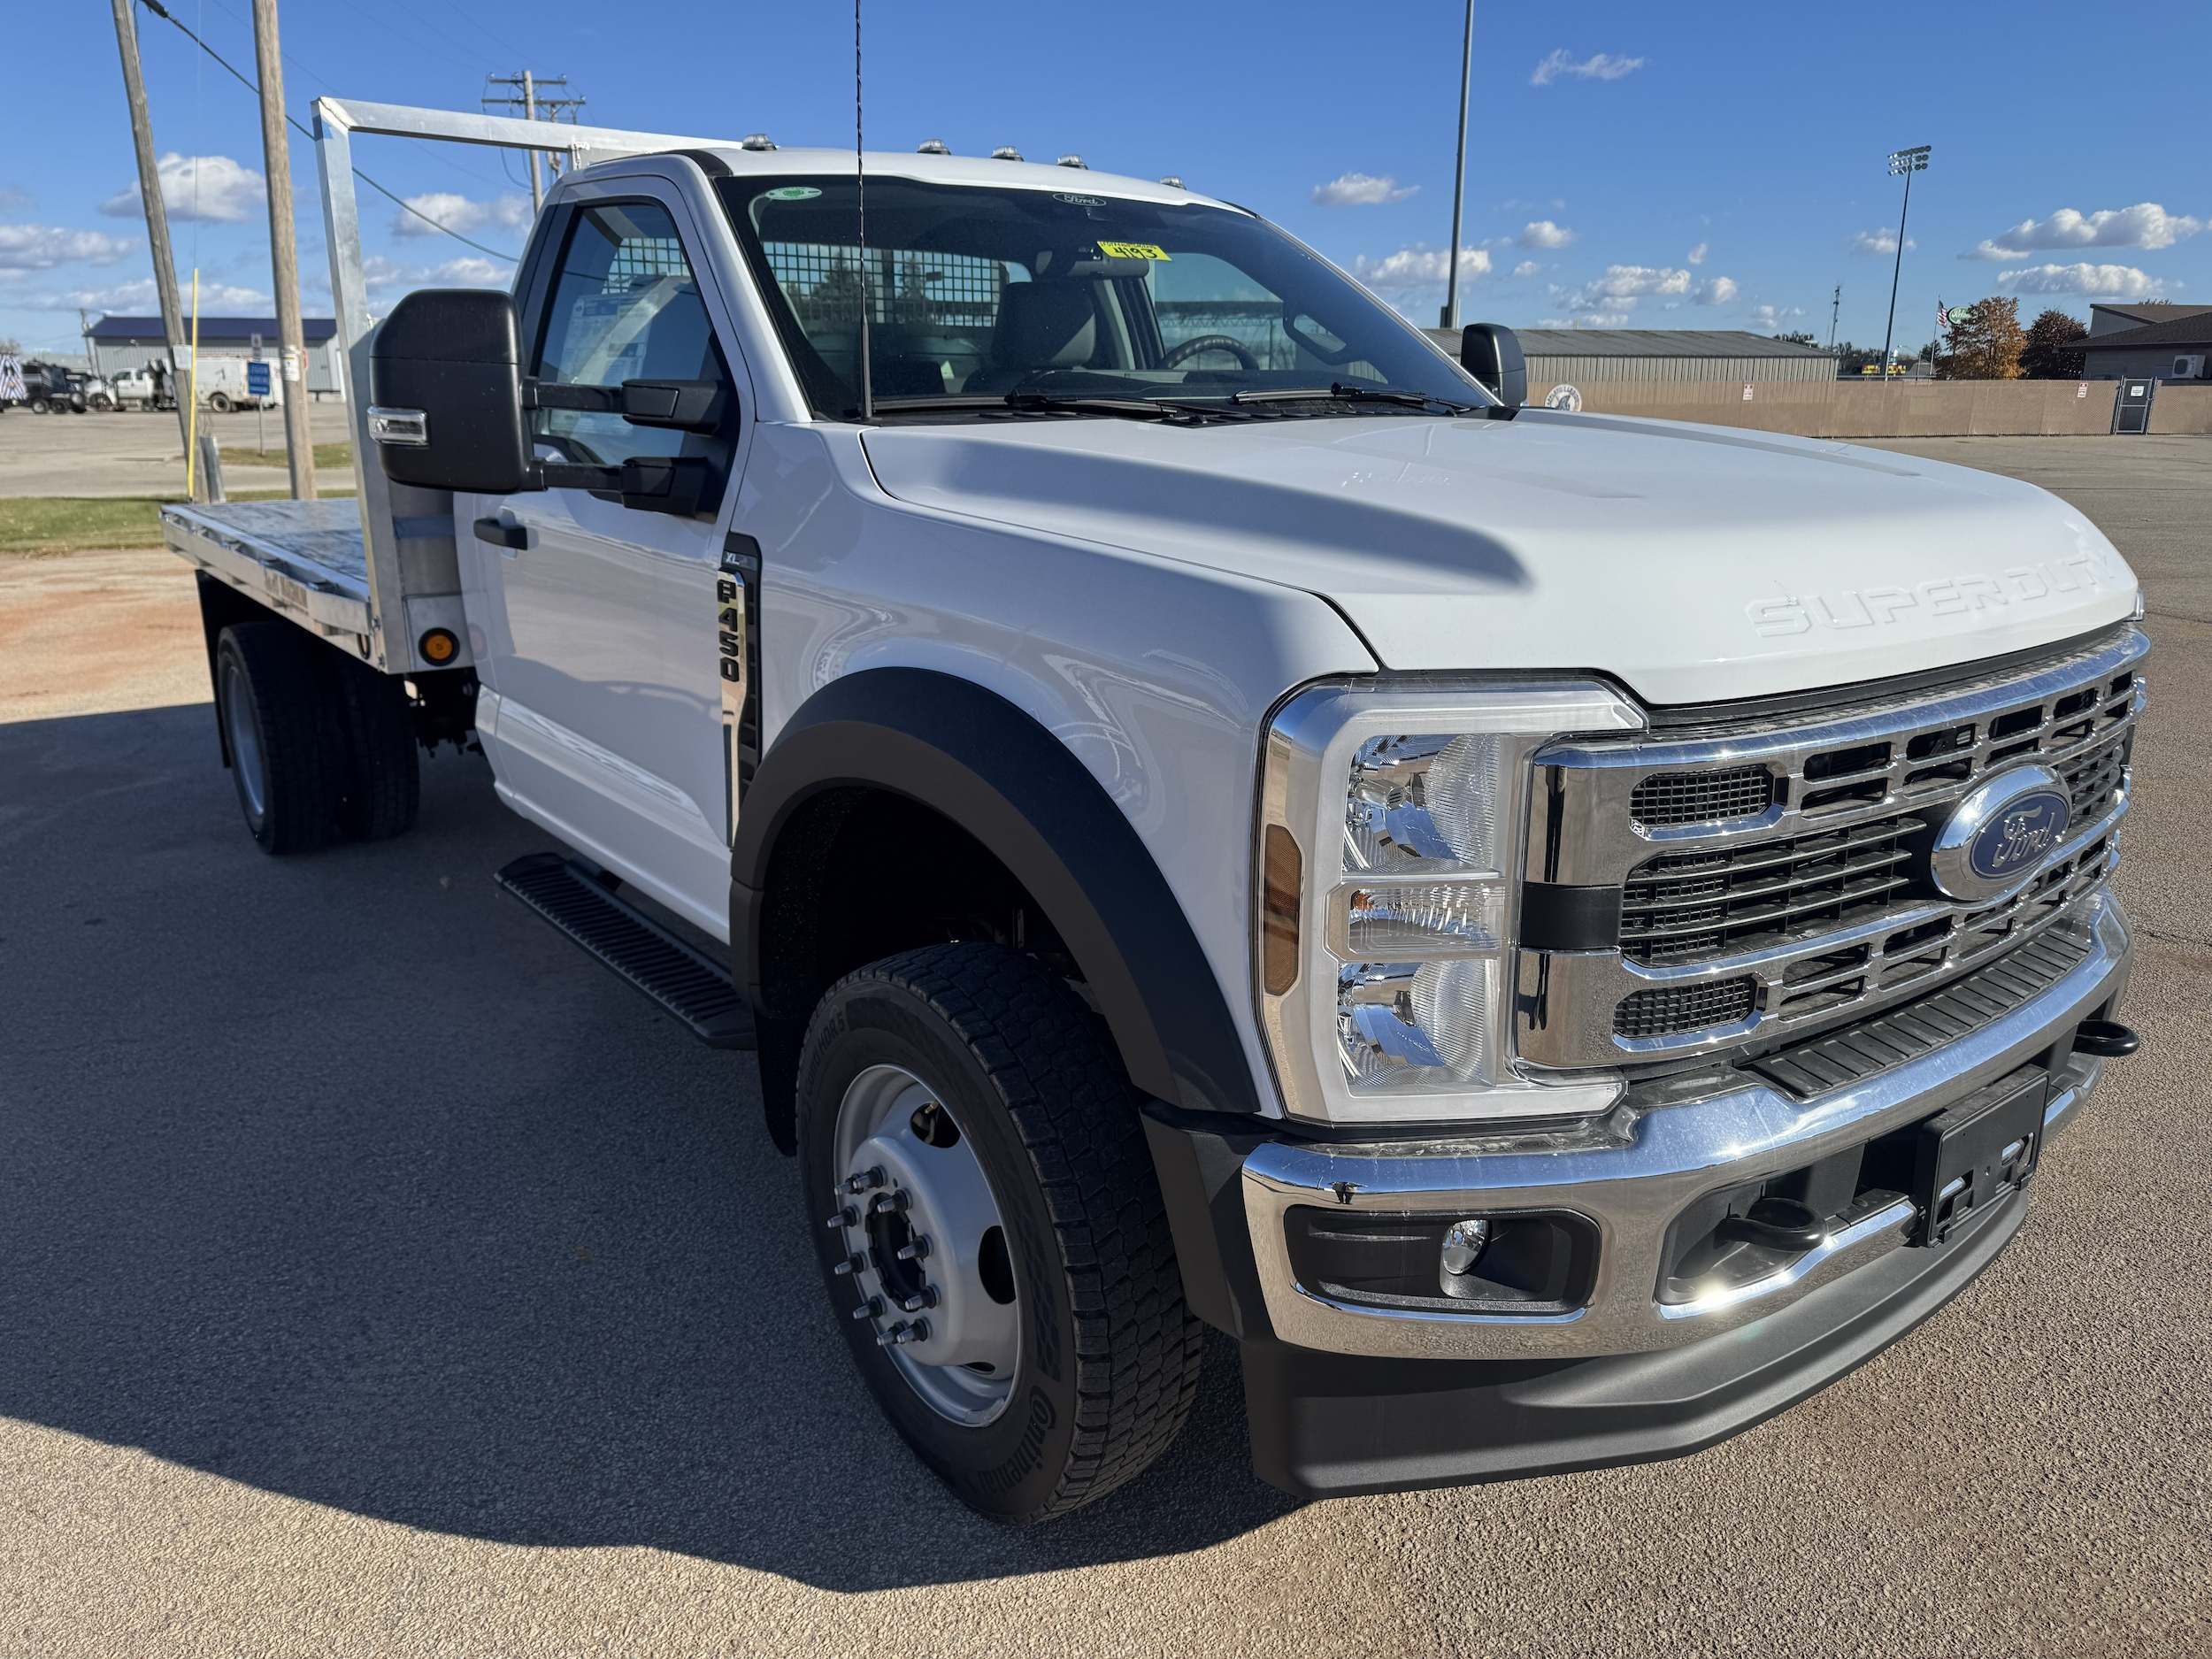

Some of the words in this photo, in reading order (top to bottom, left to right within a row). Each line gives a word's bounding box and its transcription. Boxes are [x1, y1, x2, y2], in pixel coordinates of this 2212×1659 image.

[1064, 194, 1099, 204] Ford
[1113, 247, 1158, 259] 4193
[725, 551, 741, 565] XL
[1992, 805, 2055, 868] Ford
[817, 1018, 840, 1056] HDR
[835, 1010, 846, 1033] 5
[977, 1386, 1056, 1500] Continental
